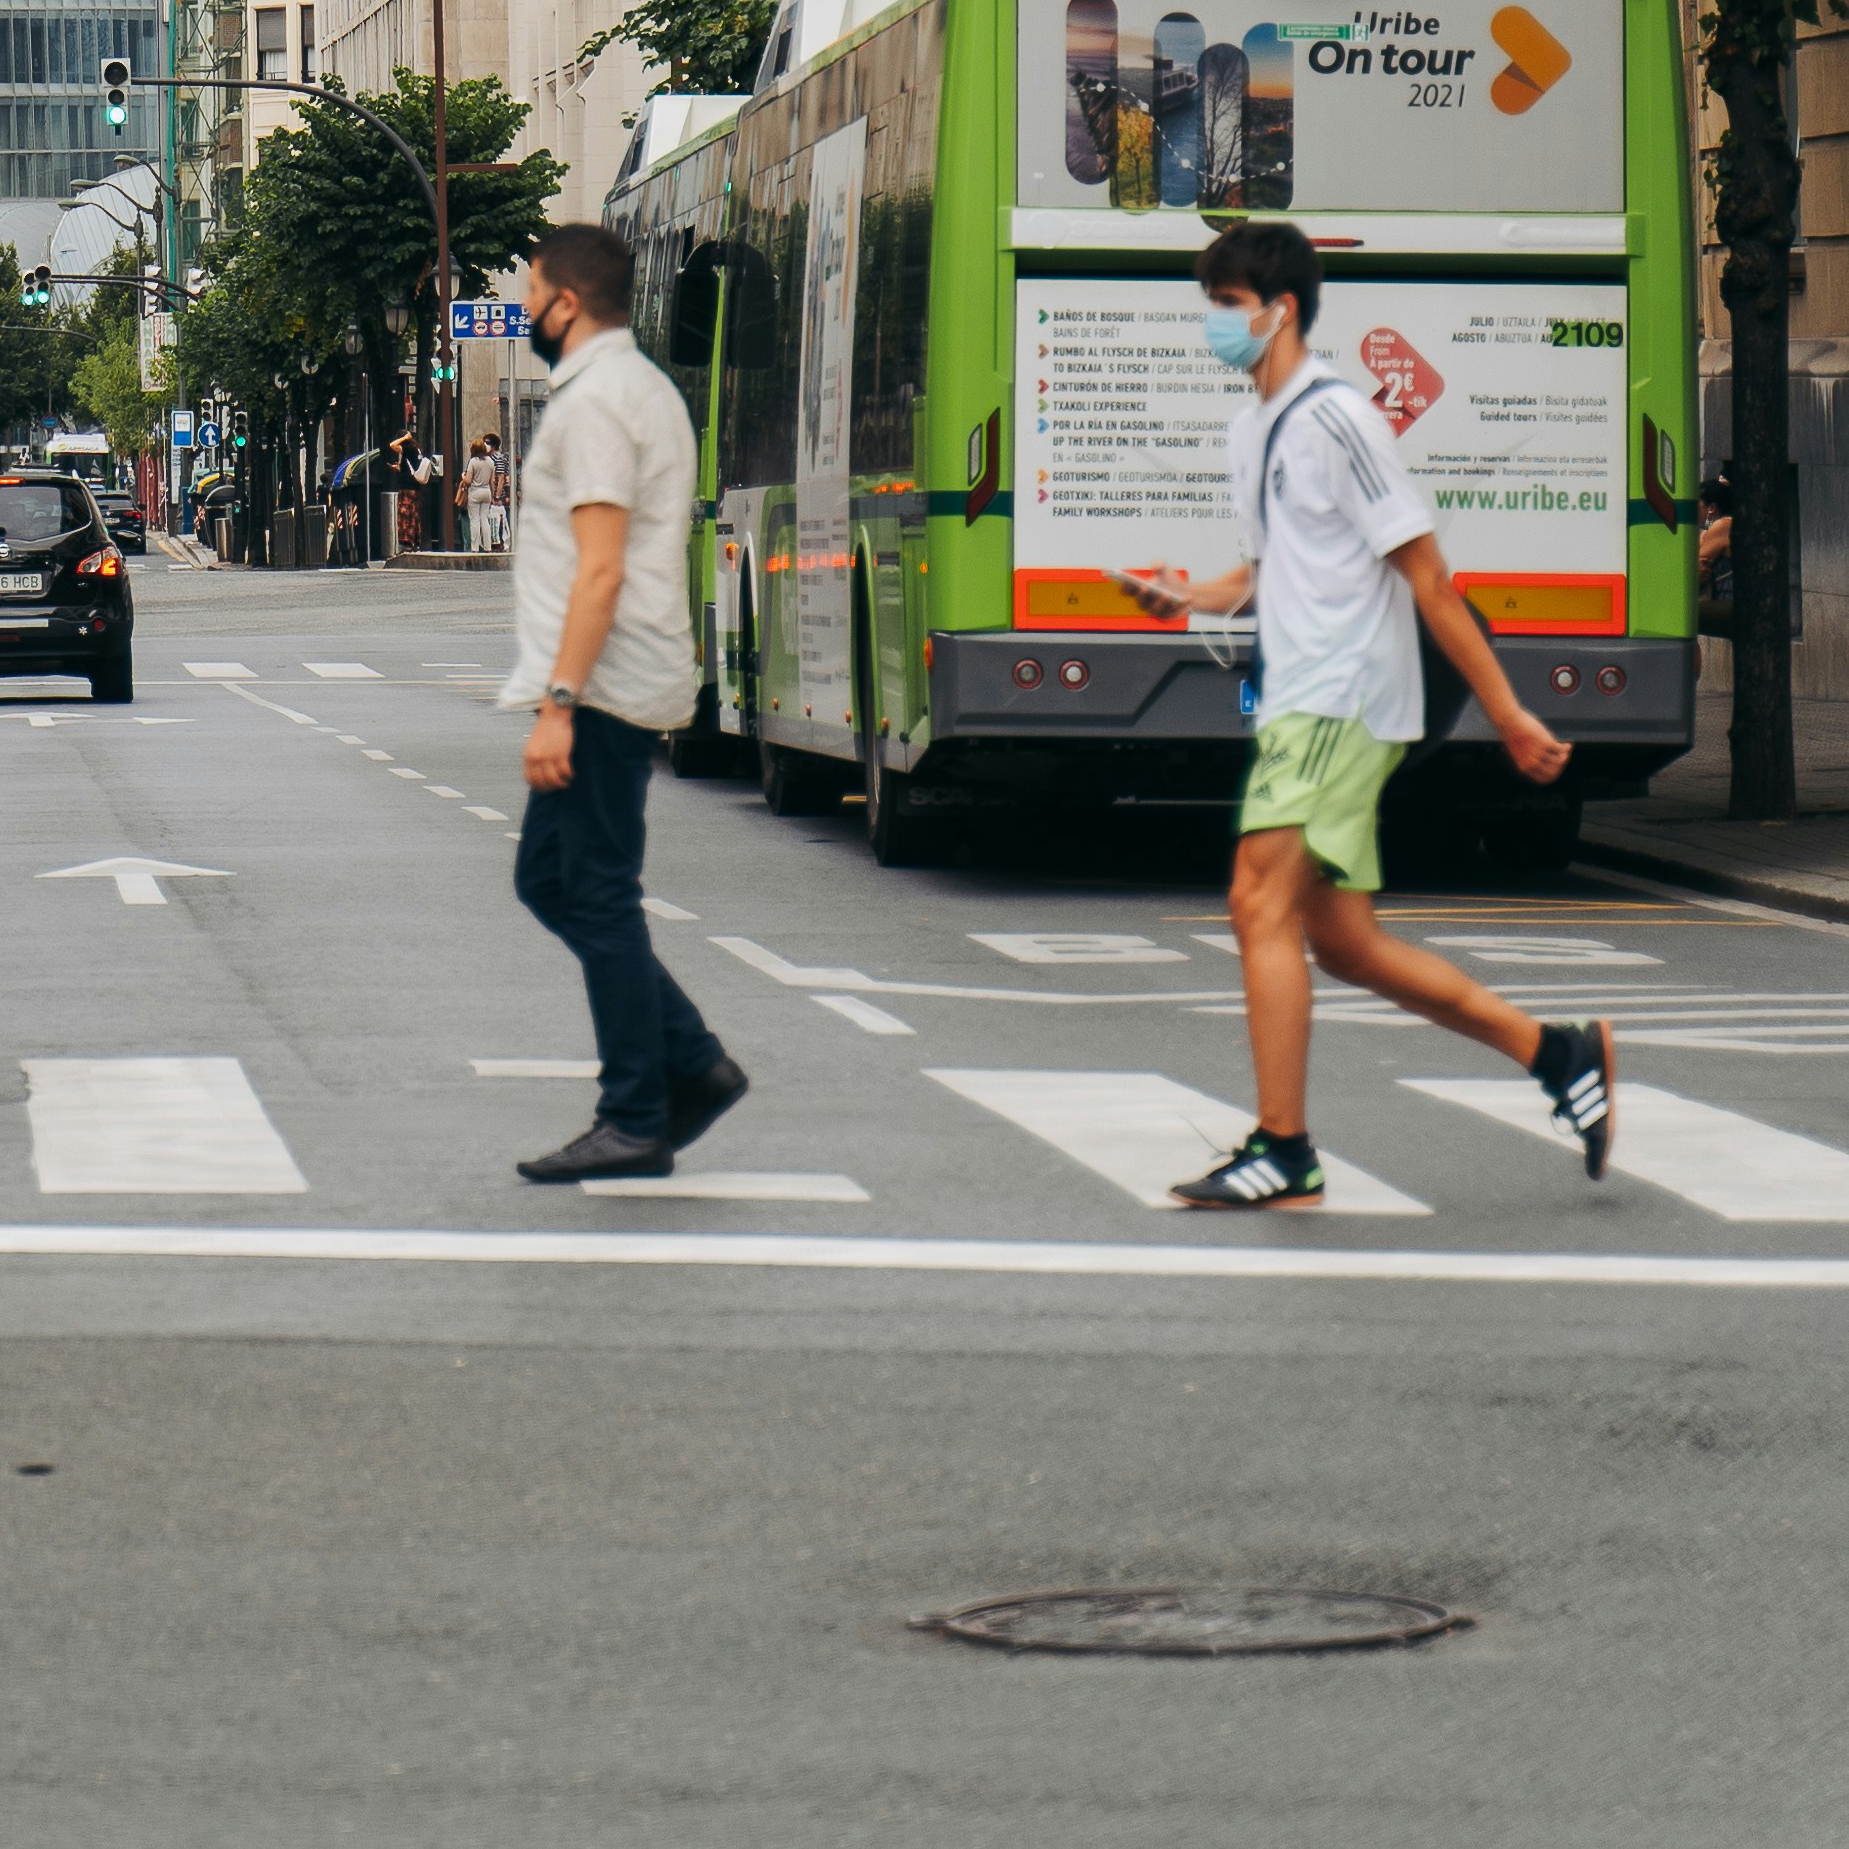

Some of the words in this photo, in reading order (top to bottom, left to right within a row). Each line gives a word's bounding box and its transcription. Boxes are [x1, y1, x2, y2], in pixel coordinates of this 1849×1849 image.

[1354, 11, 1440, 35] Uribe
[1308, 40, 1373, 74] On
[1380, 44, 1476, 75] tour
[1408, 84, 1465, 107] 2021
[1053, 309, 1084, 322] BAÑOS
[1086, 313, 1097, 322] DE
[1101, 312, 1135, 322] BOSQUE
[1144, 313, 1177, 322] BASOAN
[1469, 317, 1494, 327] JULIO
[1053, 328, 1078, 338] BAINS
[1081, 328, 1092, 338] DE
[1452, 333, 1486, 343] AGOSTO
[1552, 322, 1624, 347] 2109
[1369, 334, 1396, 344] Desde
[1053, 347, 1085, 357] RUMBO
[1088, 347, 1099, 357] AL
[1102, 347, 1134, 357] FLYSCH
[1137, 348, 1148, 357] DE
[1151, 347, 1186, 358] BIZKAIA
[1369, 346, 1390, 356] From
[1053, 364, 1064, 373] TO
[1117, 364, 1150, 374] FLYSCH
[1157, 365, 1173, 374] CAP
[1175, 365, 1193, 374] SUR
[1195, 365, 1205, 374] LE
[1403, 359, 1414, 368] de
[1053, 380, 1098, 392] CINTURÓN
[1101, 383, 1112, 392] DE
[1115, 383, 1148, 393] HIERRO
[1156, 383, 1188, 393] BURDIN
[1191, 383, 1215, 394] HESIA
[1223, 383, 1245, 394] IRON
[1053, 402, 1091, 411] TXAKOLI
[1093, 402, 1147, 411] EXPERIENCE
[1470, 395, 1500, 405] Visitas
[1502, 395, 1537, 407] guiadas
[1480, 411, 1510, 422] Guided
[1514, 412, 1537, 422] tours
[1053, 421, 1071, 430] POR
[1074, 421, 1085, 430] LA
[1088, 418, 1102, 430] RÍA
[1106, 421, 1117, 430] EN
[1120, 421, 1164, 430] GASOLINO
[1053, 437, 1065, 446] UP
[1068, 437, 1085, 446] THE
[1087, 437, 1113, 447] RIVER
[1116, 437, 1129, 447] ON
[1132, 437, 1148, 447] THE
[1053, 453, 1064, 463] EN
[1075, 453, 1116, 463] GASOLINO
[1053, 472, 1110, 482] GEOTURISMO
[1118, 473, 1178, 482] GEOTURISMOA
[1053, 491, 1096, 501] GEOTXIKI:
[1100, 492, 1143, 502] TALLERES
[1145, 492, 1169, 502] PARA
[1172, 492, 1213, 502] FAMILIAS
[1435, 484, 1608, 511] www.uribe.eu
[1053, 508, 1083, 517] FAMILY
[1086, 508, 1142, 518] WORKSHOPS
[1151, 508, 1189, 518] ATELIERS
[1192, 509, 1214, 519] POUR
[13, 576, 39, 588] HCB
